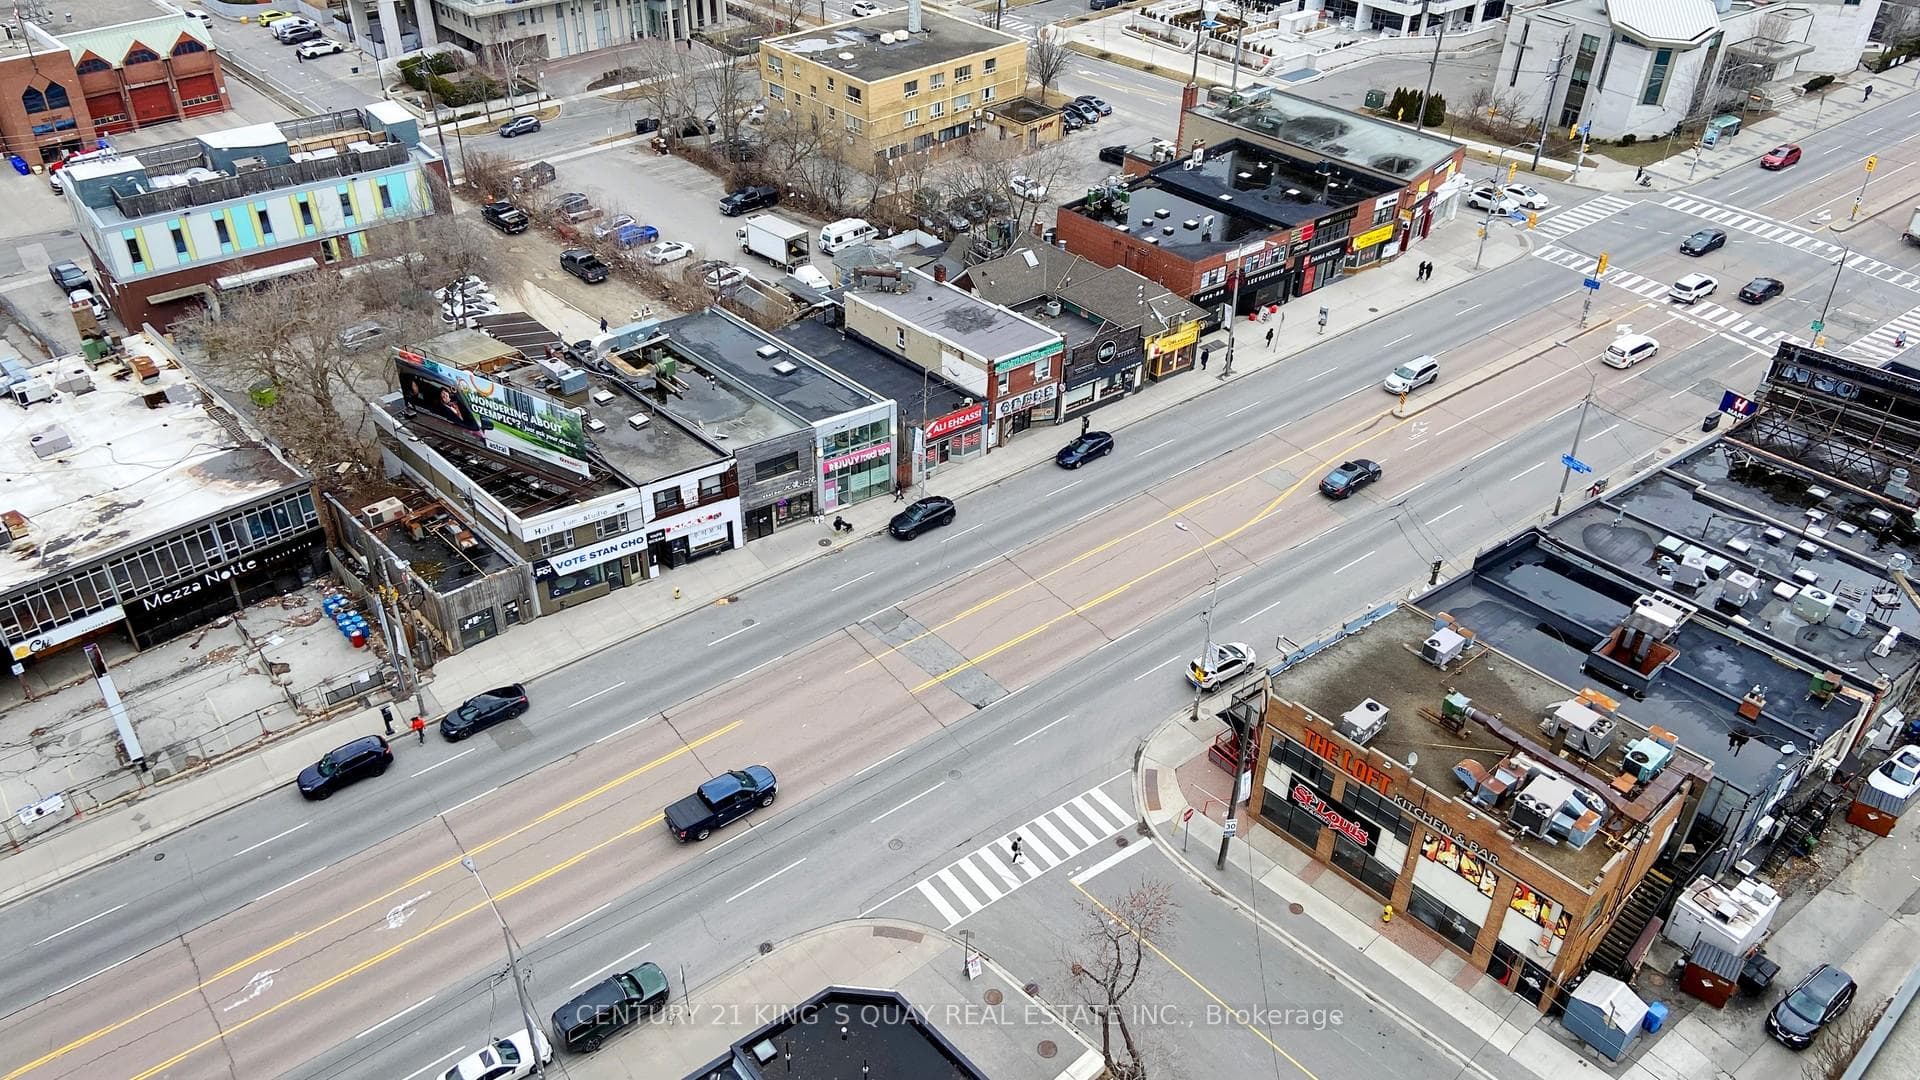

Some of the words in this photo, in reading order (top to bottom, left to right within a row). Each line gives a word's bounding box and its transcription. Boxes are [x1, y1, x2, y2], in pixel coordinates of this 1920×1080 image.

[469, 393, 528, 421] WONDERING
[530, 416, 563, 433] ABOUT
[933, 421, 947, 434] ALI
[947, 409, 982, 428] EHSASSI
[488, 442, 507, 453] astral
[556, 554, 587, 569] VOTE
[589, 545, 618, 559] STAN
[620, 536, 644, 550] CHO
[143, 582, 201, 611] Mezza
[205, 560, 257, 586] Notte
[1304, 727, 1340, 764] THE
[1342, 749, 1393, 796] LOFT
[1316, 799, 1369, 846] Louis
[1393, 794, 1454, 836] KITCHEN
[1455, 832, 1466, 845] &
[1468, 840, 1500, 865] BAR
